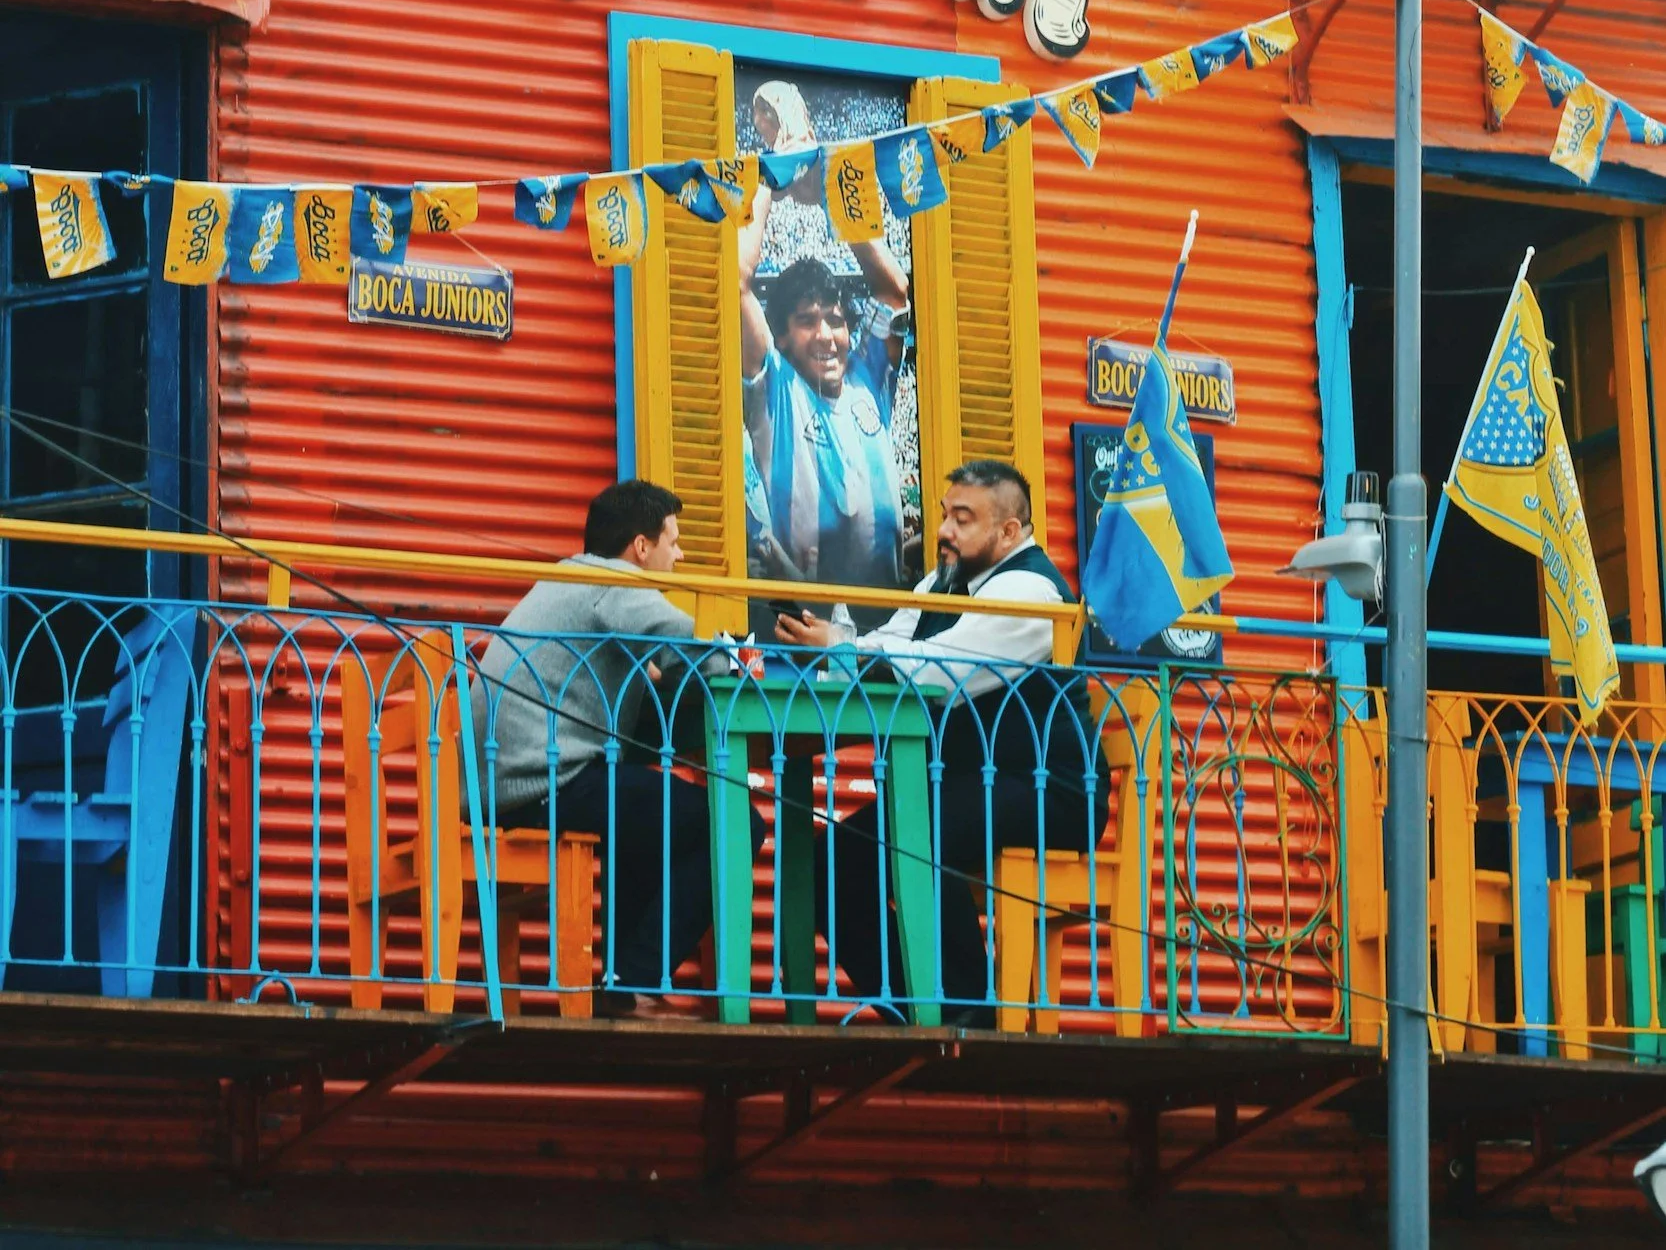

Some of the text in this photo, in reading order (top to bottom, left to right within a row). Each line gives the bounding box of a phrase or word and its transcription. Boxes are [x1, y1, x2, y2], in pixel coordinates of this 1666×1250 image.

[51, 184, 80, 254] Boca
[597, 186, 625, 248] Boca
[842, 159, 864, 222] Boca
[186, 198, 217, 266] Boca
[307, 195, 335, 262] Boca
[357, 273, 508, 328] BOCA JUNIORS
[393, 264, 472, 285] AVENIDA
[1097, 359, 1231, 413] BOC NIORS
[1128, 351, 1198, 372] AVIDA
